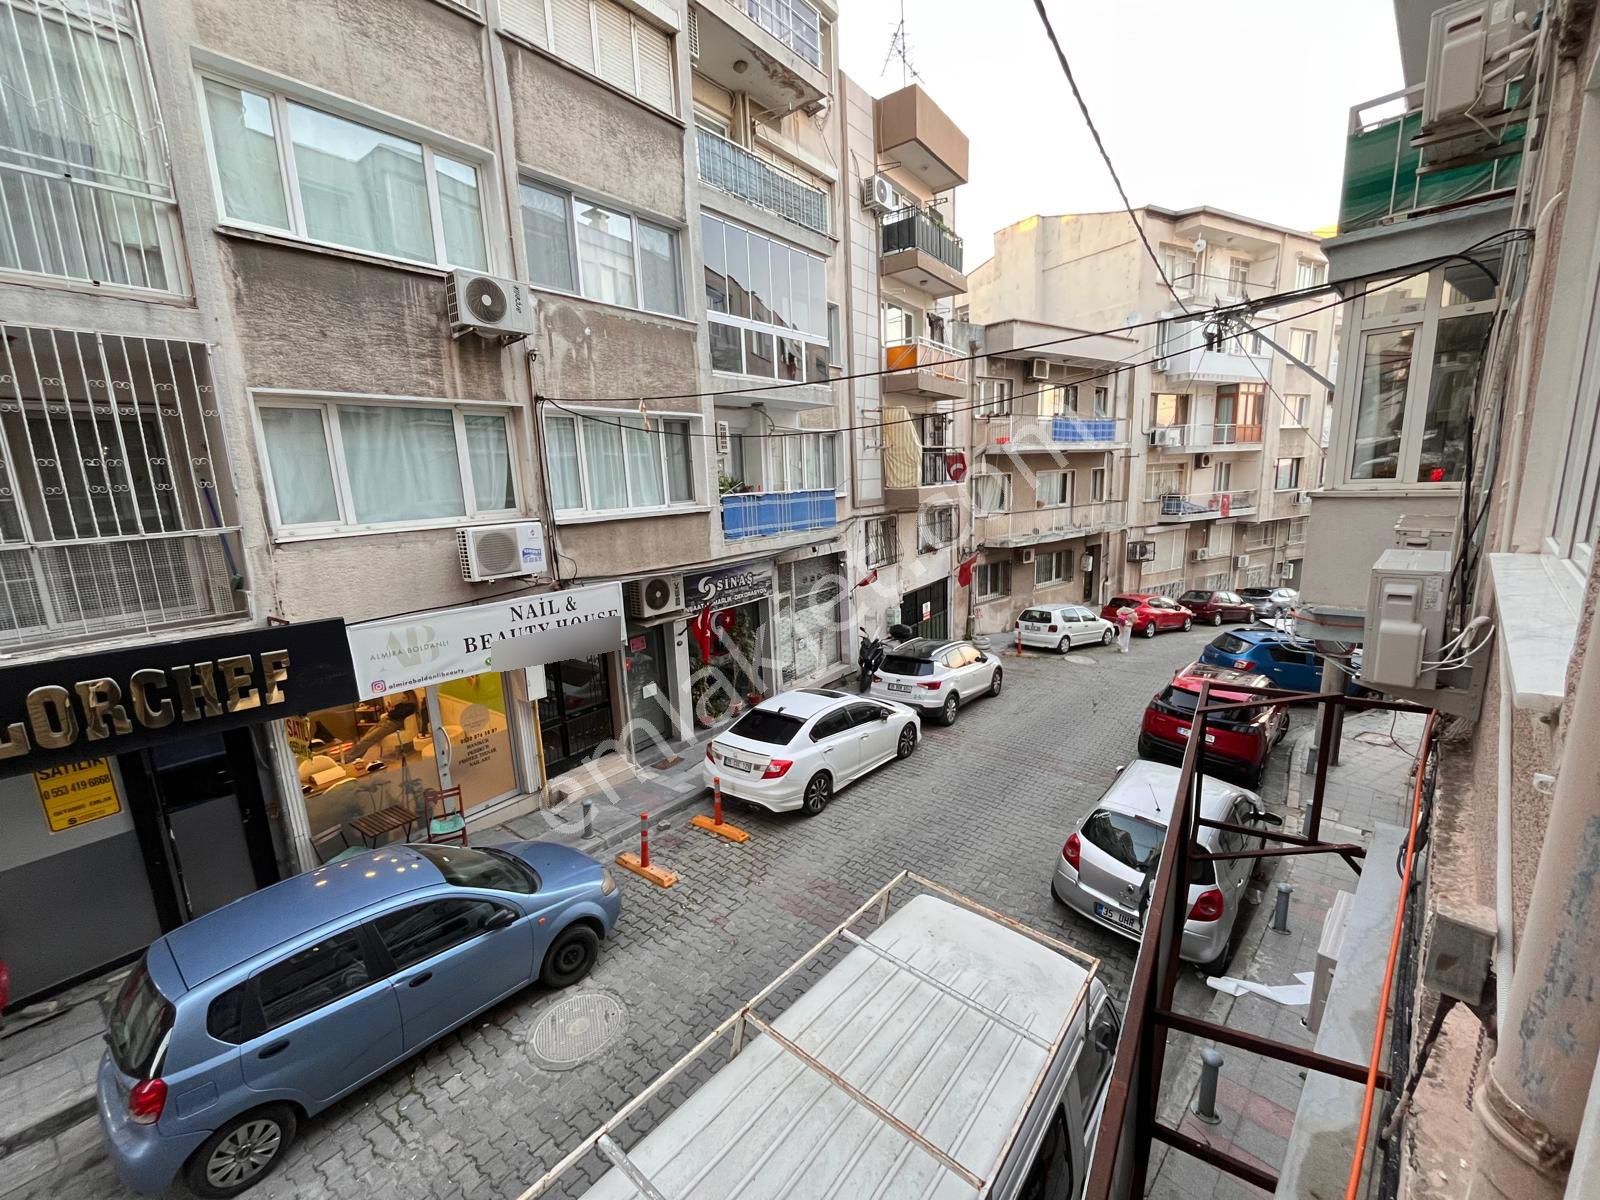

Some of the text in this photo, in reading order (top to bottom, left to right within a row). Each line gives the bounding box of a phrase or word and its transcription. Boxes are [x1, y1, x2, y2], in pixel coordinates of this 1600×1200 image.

[716, 572, 753, 591] SİNAŞ
[510, 595, 577, 622] NAİL &
[43, 790, 50, 800] 0
[1103, 906, 1113, 918] 35
